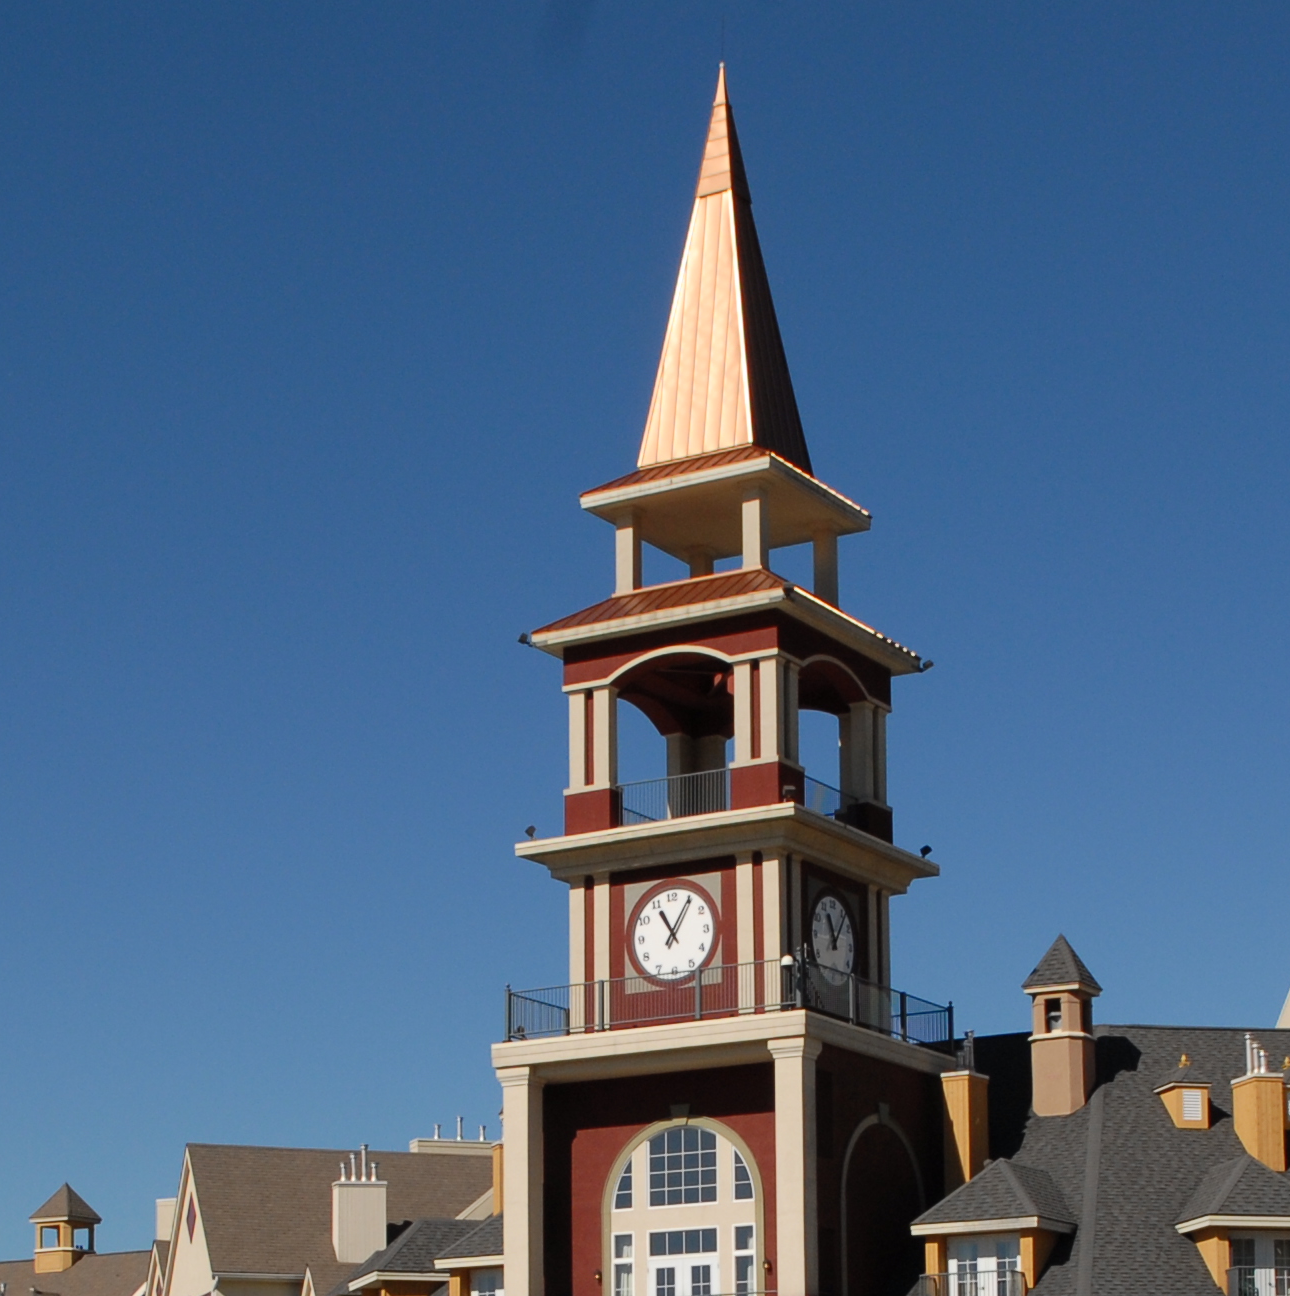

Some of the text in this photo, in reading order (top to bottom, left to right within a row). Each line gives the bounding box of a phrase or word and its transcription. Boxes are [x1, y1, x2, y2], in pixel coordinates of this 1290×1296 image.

[667, 892, 678, 902] 12
[652, 900, 662, 909] 11
[698, 906, 704, 915] 2
[638, 916, 650, 926] 10
[703, 924, 710, 933] 3
[638, 936, 645, 944] 9
[699, 943, 705, 952] 4
[643, 952, 650, 961] 8
[689, 959, 695, 968] 5
[656, 965, 662, 975] 7
[671, 967, 678, 975] 6
